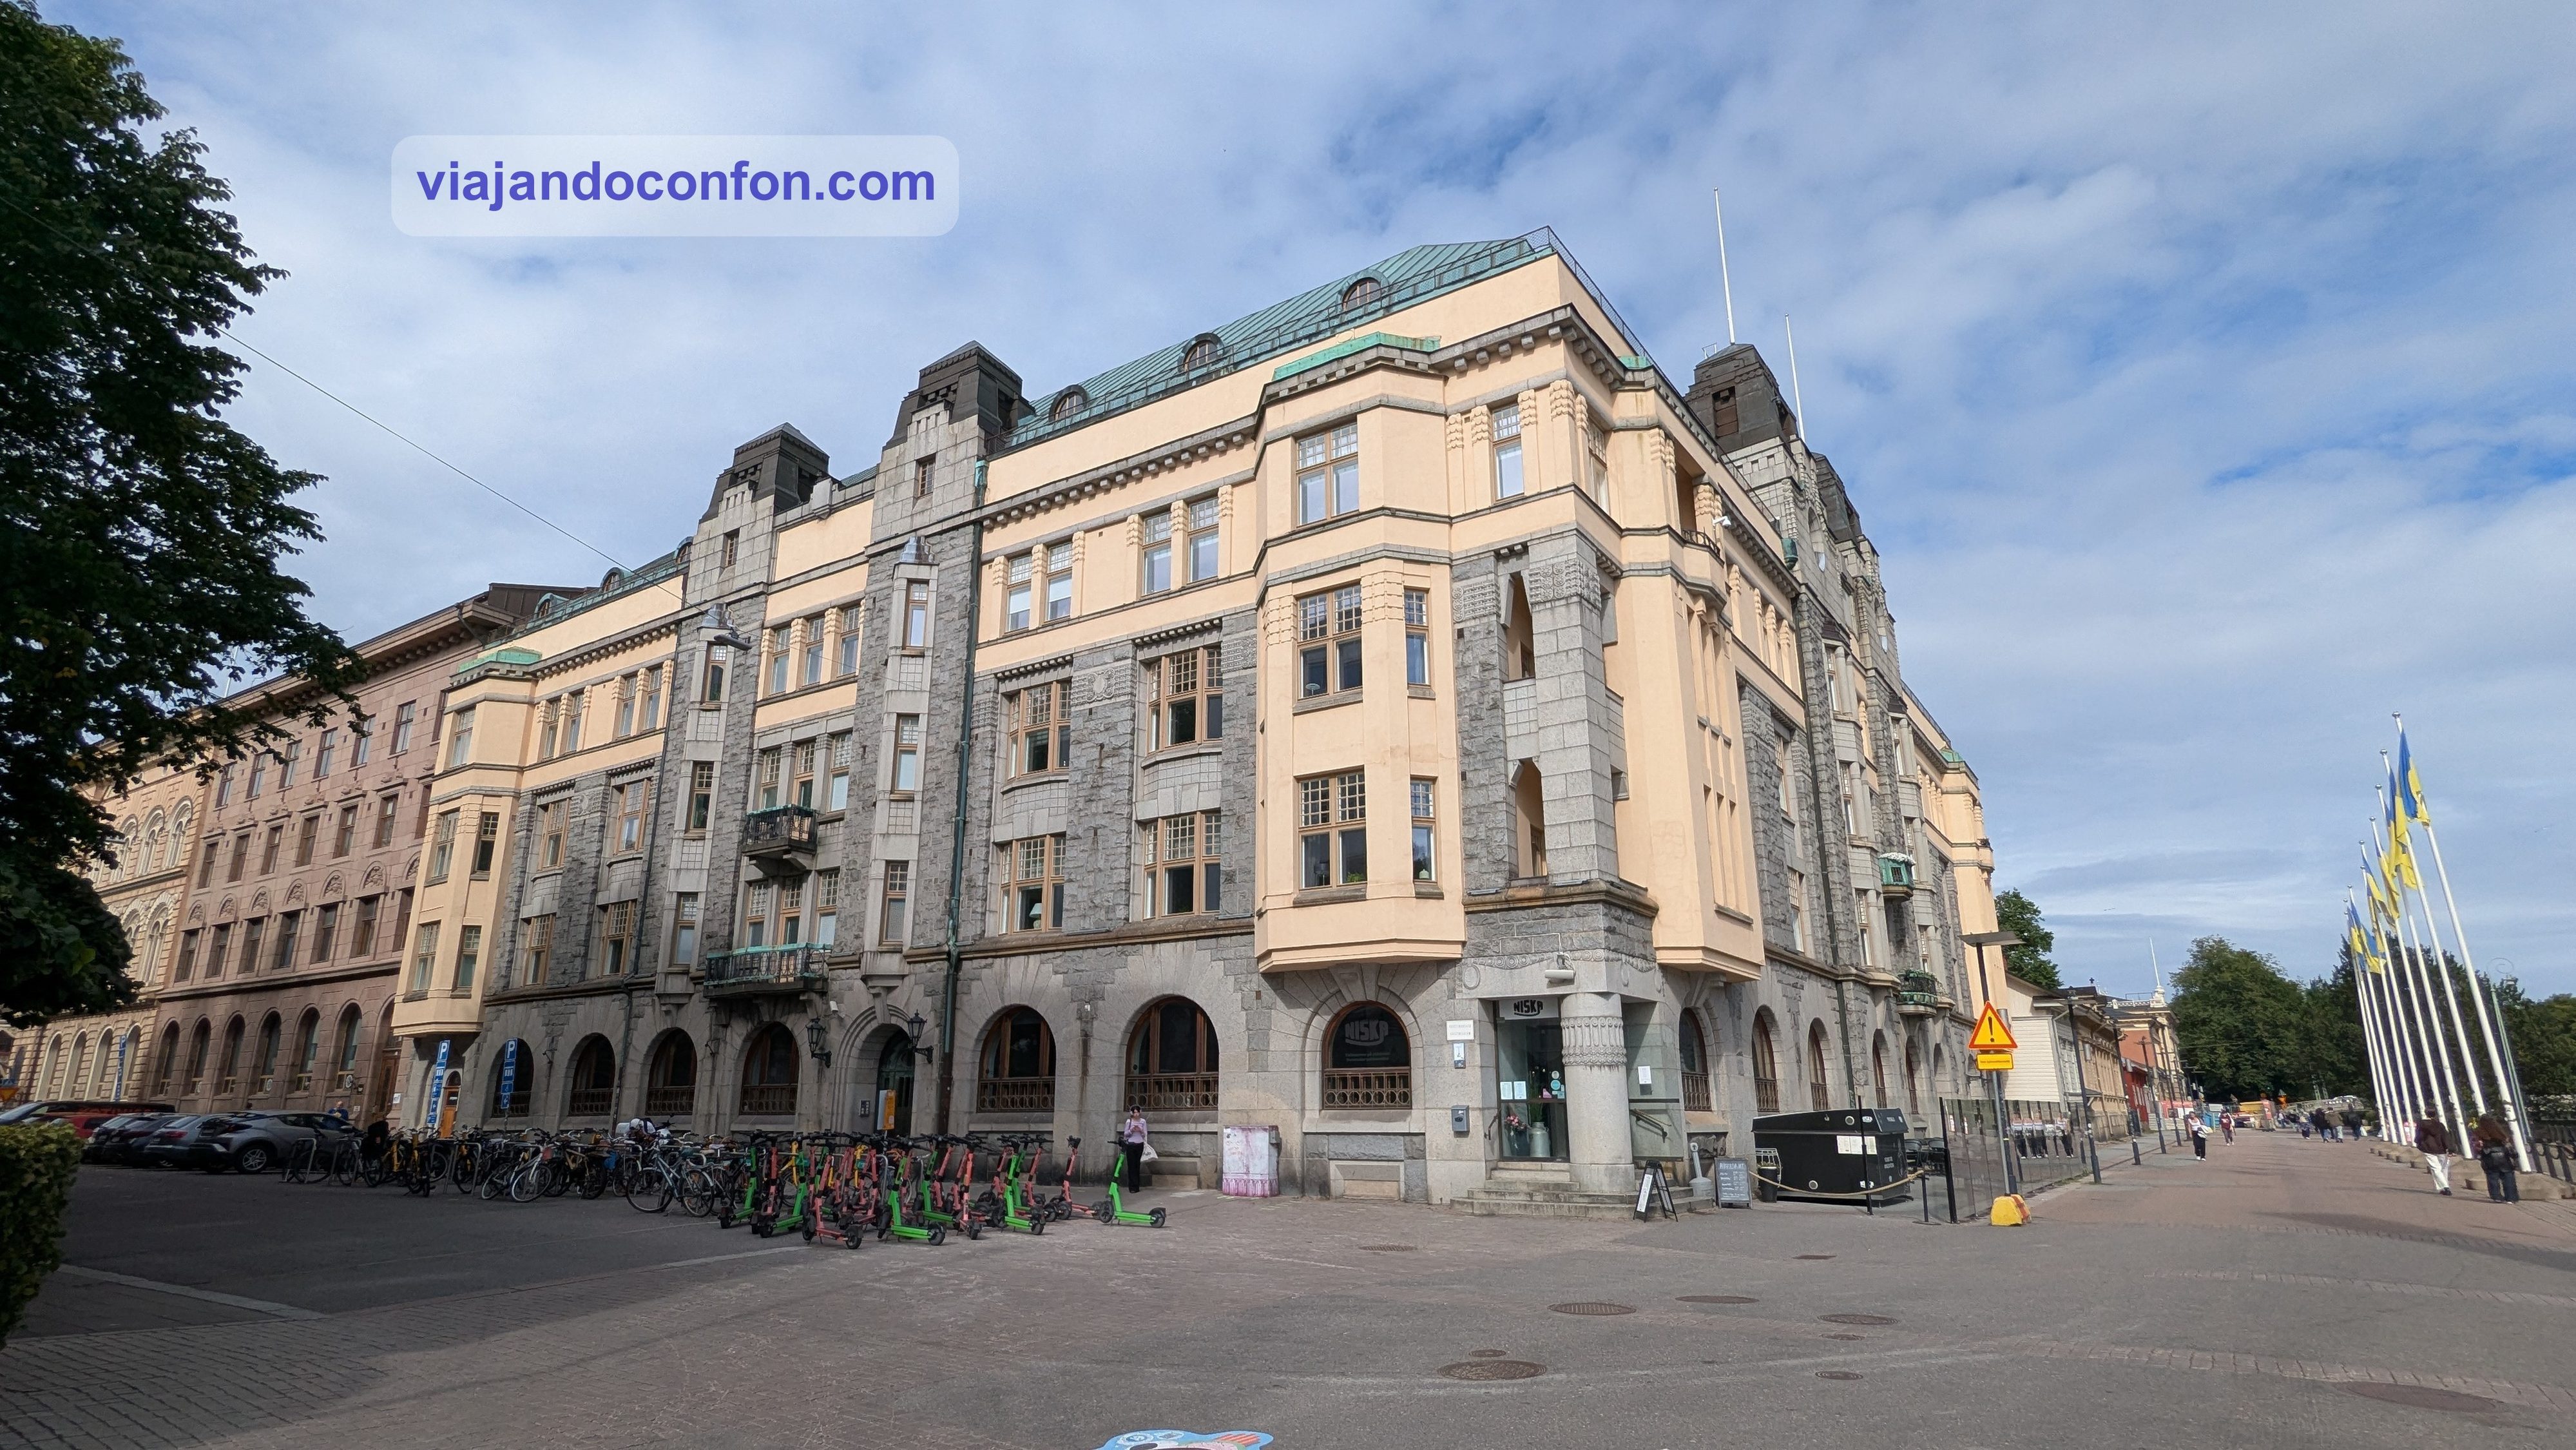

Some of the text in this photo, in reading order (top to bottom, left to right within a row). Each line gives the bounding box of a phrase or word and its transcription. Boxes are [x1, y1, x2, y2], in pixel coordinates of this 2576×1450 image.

[1514, 1000, 1543, 1016] NISKA
[1345, 1019, 1389, 1046] NISKA
[439, 1042, 448, 1059] P
[507, 1041, 515, 1058] P
